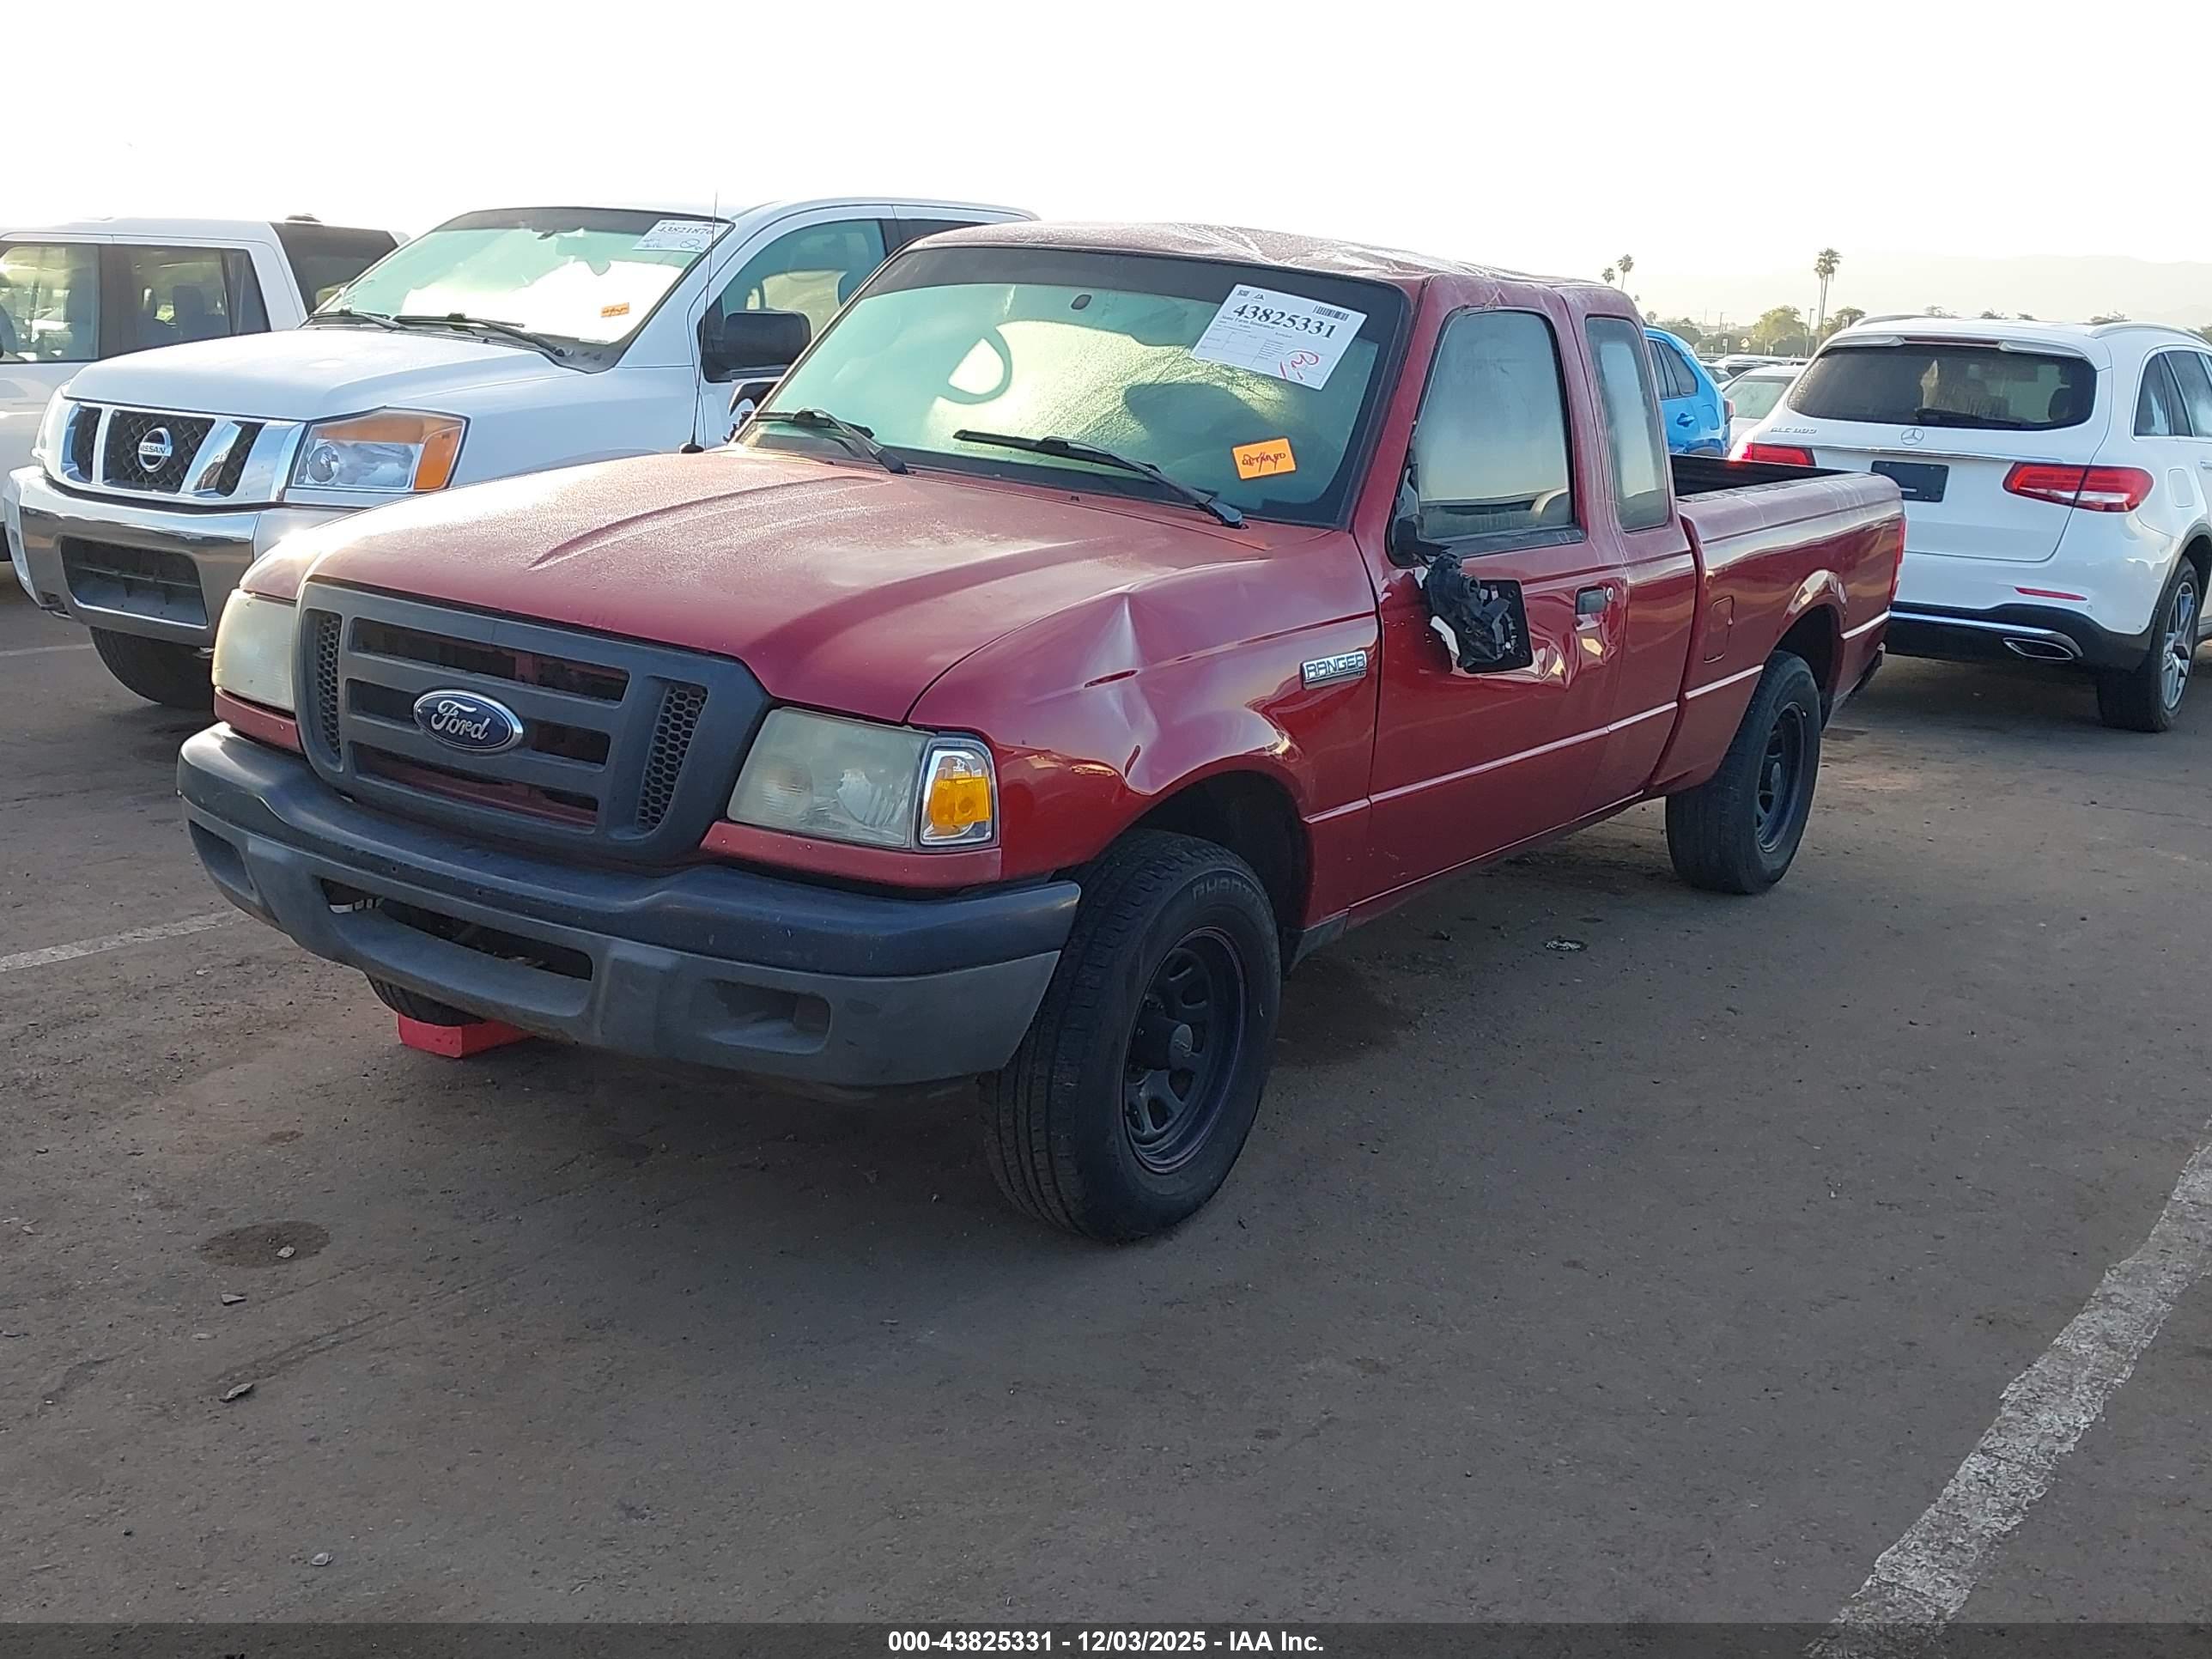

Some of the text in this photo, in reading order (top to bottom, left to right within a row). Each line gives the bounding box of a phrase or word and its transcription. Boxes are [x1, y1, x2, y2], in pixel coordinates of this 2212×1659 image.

[1232, 304, 1337, 338] 43825331
[1305, 653, 1365, 678] RANGER
[430, 700, 491, 740] Ford
